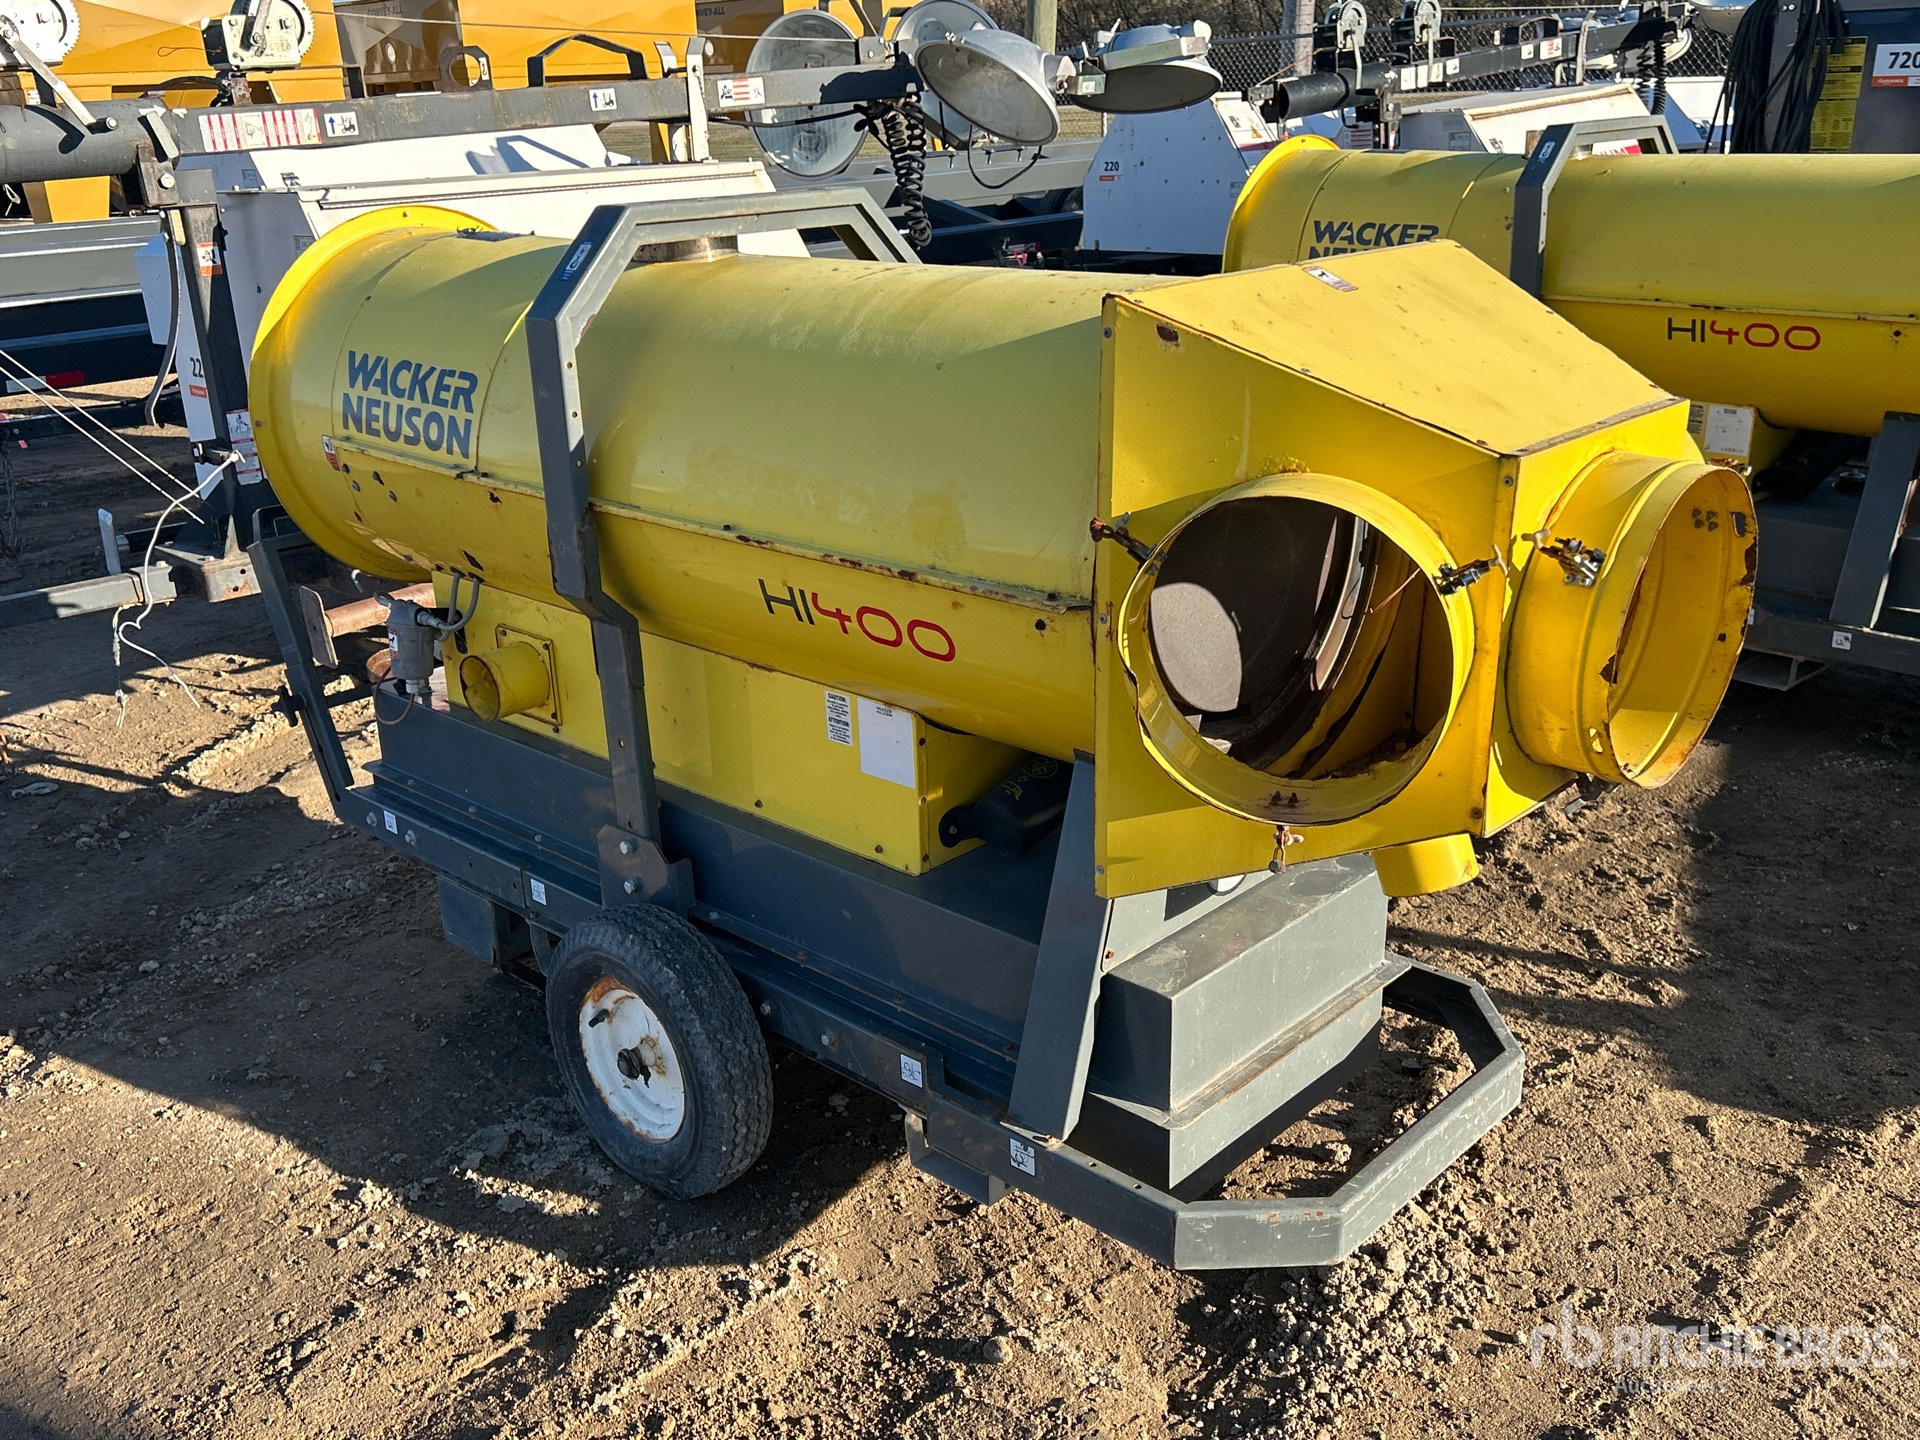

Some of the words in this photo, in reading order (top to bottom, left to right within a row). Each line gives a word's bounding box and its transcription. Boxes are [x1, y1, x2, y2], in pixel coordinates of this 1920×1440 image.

[1888, 51, 1920, 69] 720
[1104, 161, 1120, 172] 220
[1314, 220, 1440, 247] WACKER
[1667, 317, 1821, 351] HI400
[348, 350, 478, 414] WACKER
[342, 392, 472, 459] NEUSON
[758, 578, 956, 662] HI400
